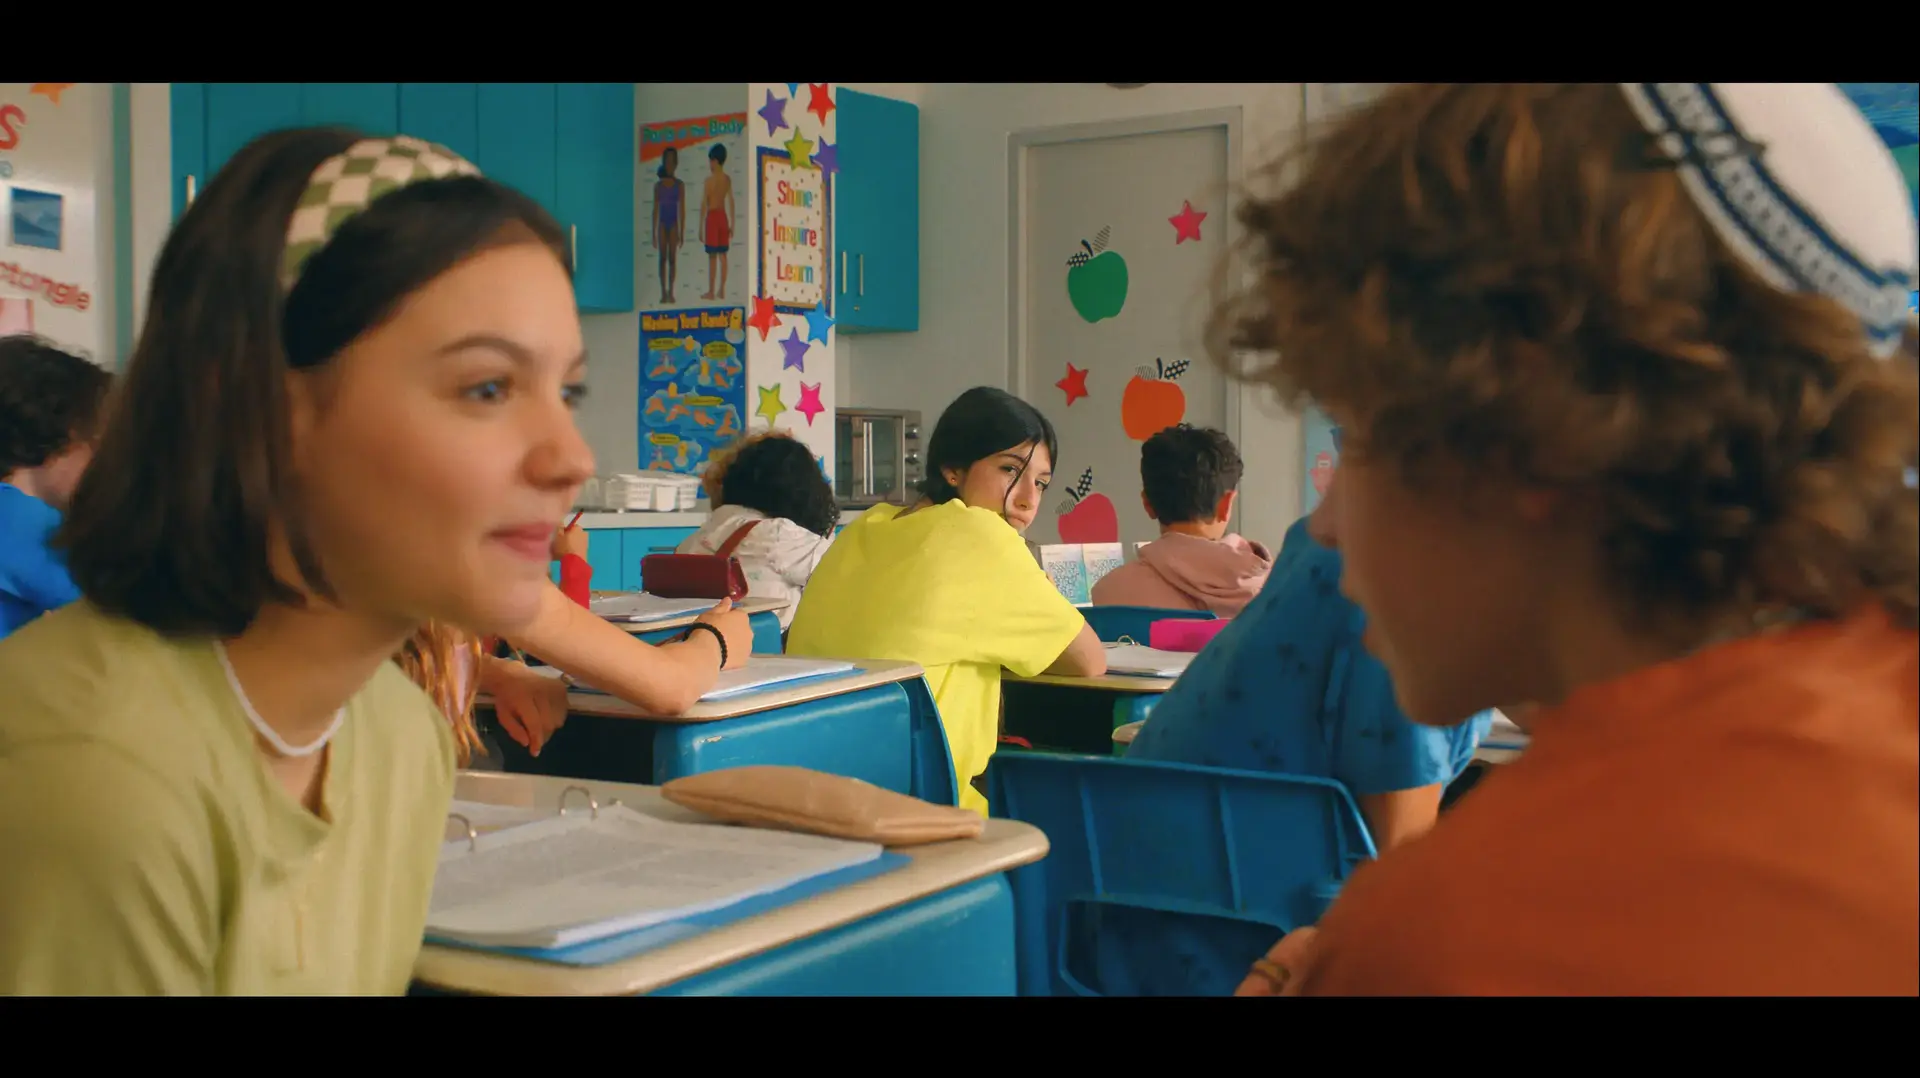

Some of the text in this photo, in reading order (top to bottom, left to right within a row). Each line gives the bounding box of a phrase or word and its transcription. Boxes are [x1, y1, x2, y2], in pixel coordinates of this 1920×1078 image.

[709, 117, 744, 136] Body
[777, 180, 812, 208] Shine
[773, 217, 816, 248] Inspire
[777, 255, 813, 283] Learn
